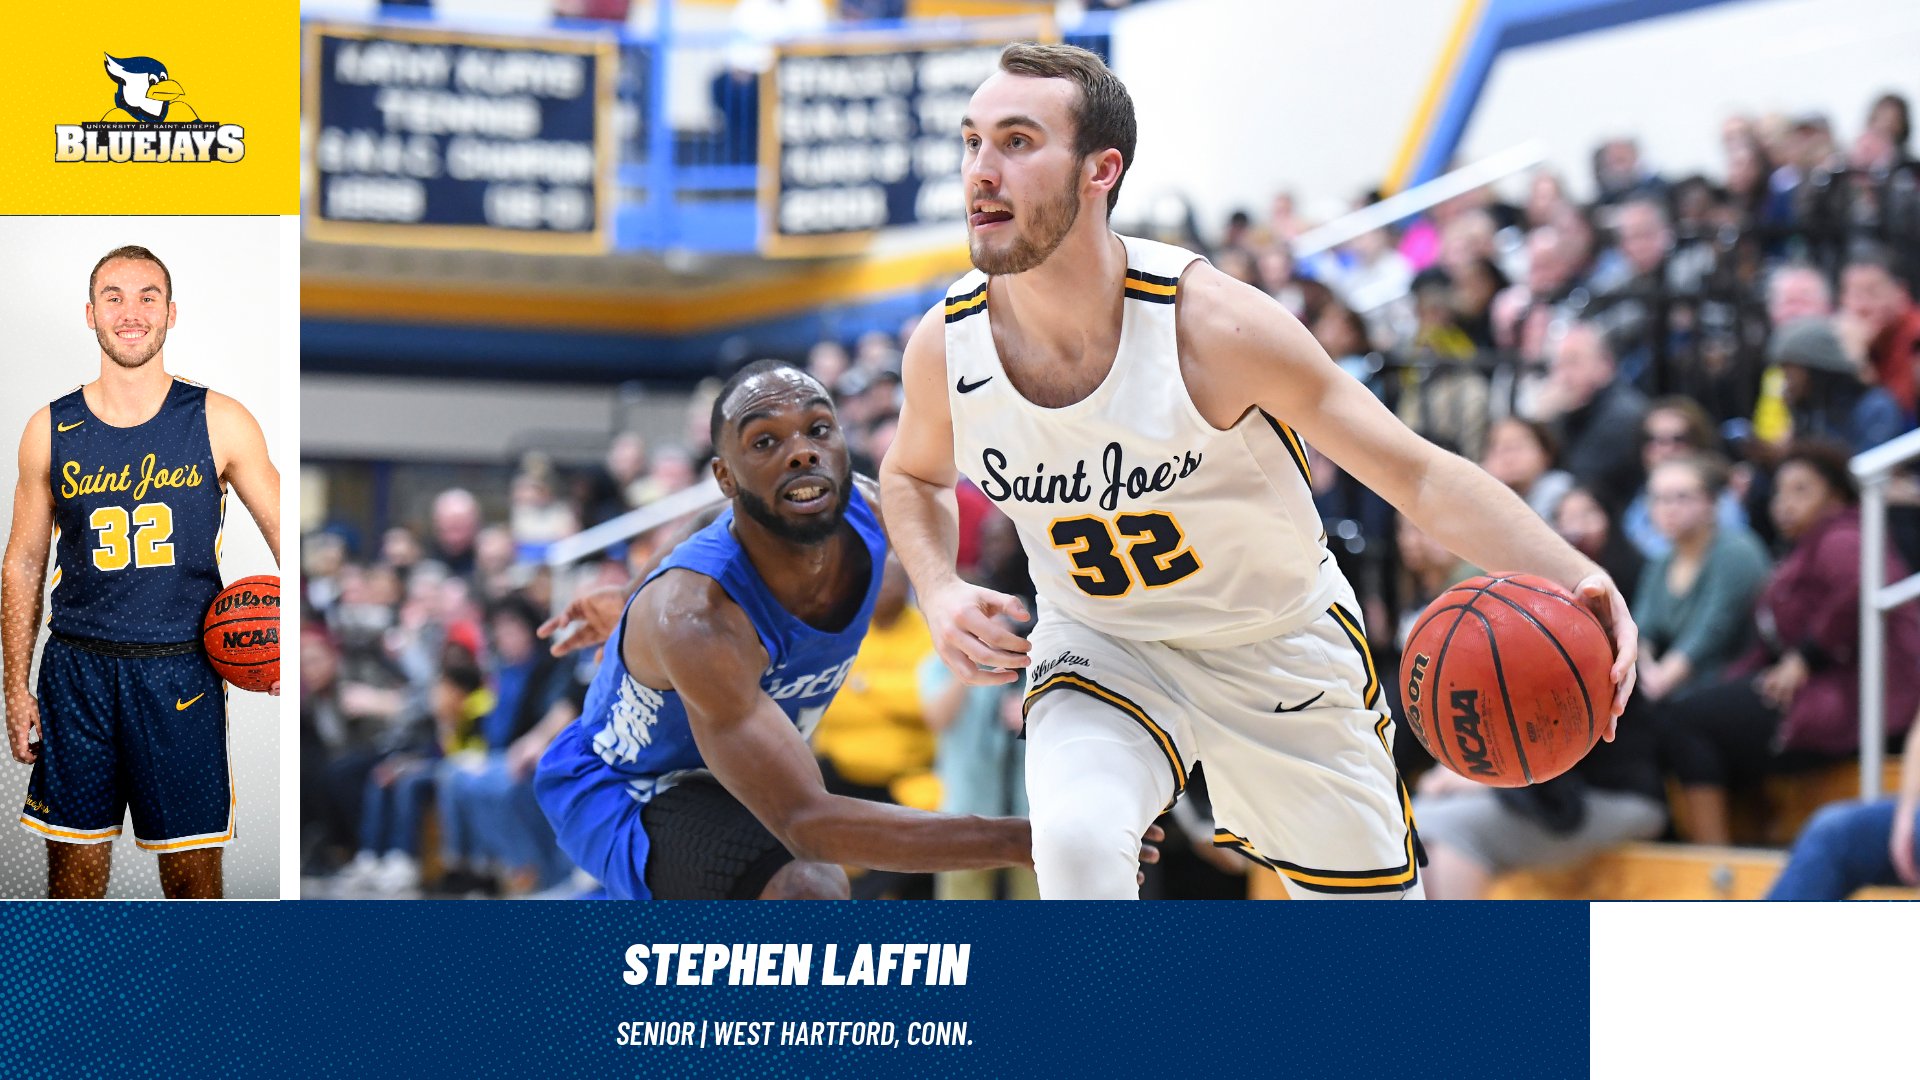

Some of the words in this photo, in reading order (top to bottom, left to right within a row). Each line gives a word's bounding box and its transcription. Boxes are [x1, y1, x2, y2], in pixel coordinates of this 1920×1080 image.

[61, 460, 132, 499] Saint
[132, 453, 203, 501] Joe's
[981, 447, 1091, 504] Saint
[1099, 441, 1203, 511] Joe's
[89, 501, 176, 572] 32
[1047, 509, 1204, 599] 32
[223, 628, 278, 648] NCAA
[1450, 690, 1500, 777] NCAA
